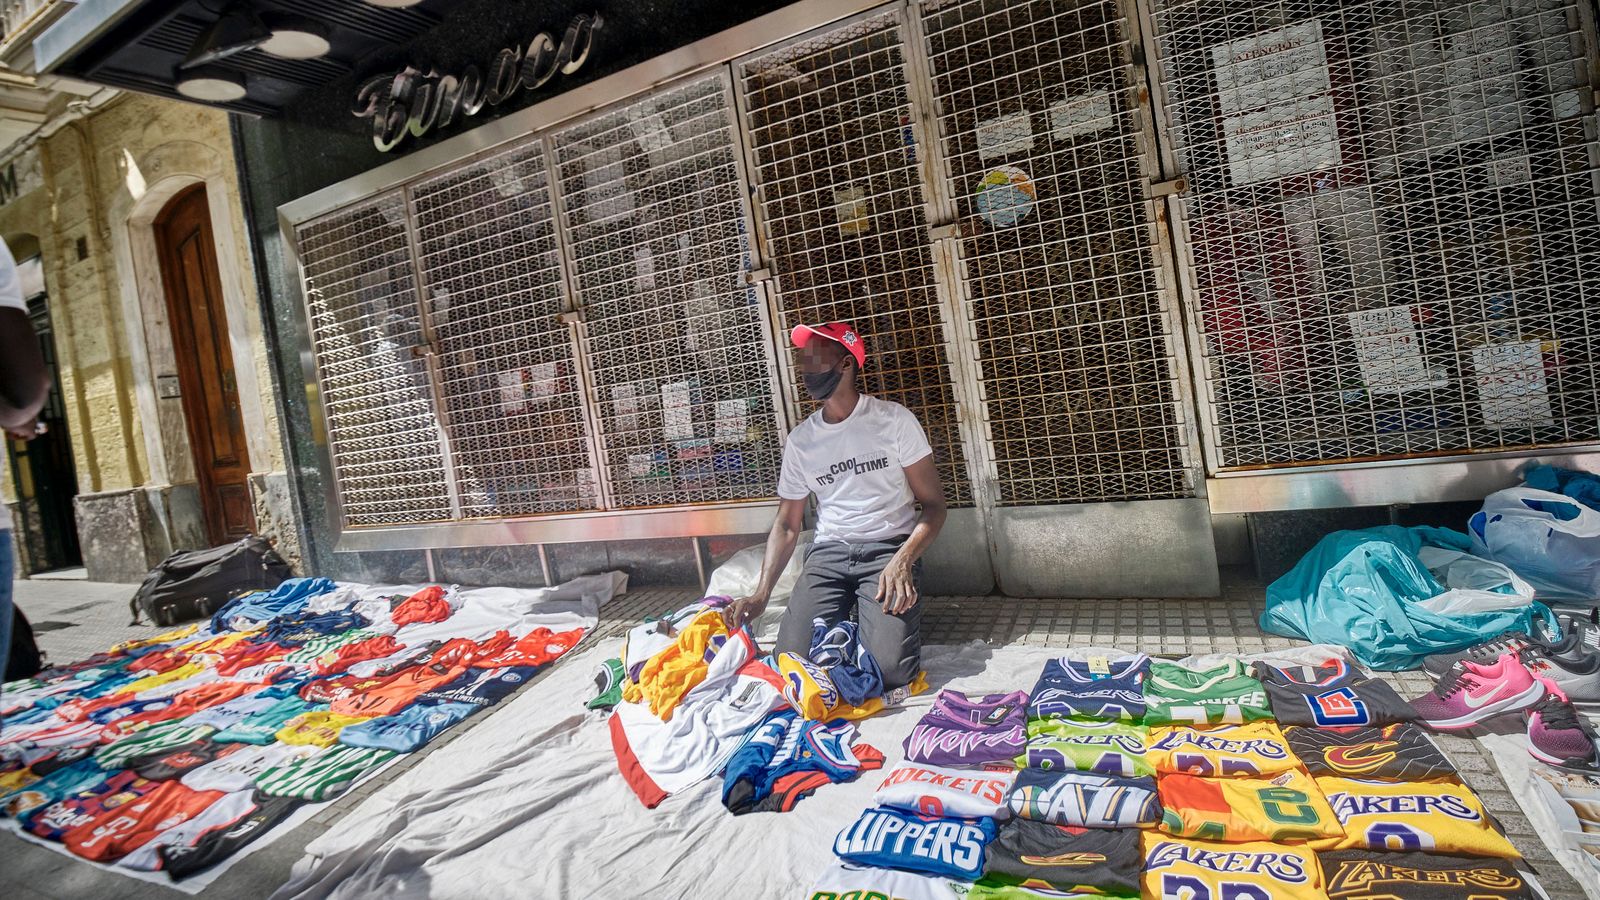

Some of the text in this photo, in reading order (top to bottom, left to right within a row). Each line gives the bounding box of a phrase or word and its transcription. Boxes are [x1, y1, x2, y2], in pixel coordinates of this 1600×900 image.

[816, 473, 835, 486] IT'S
[1148, 731, 1289, 760] LAKERS
[1142, 841, 1308, 884] LAKERS
[1328, 860, 1522, 897] LAKERS
